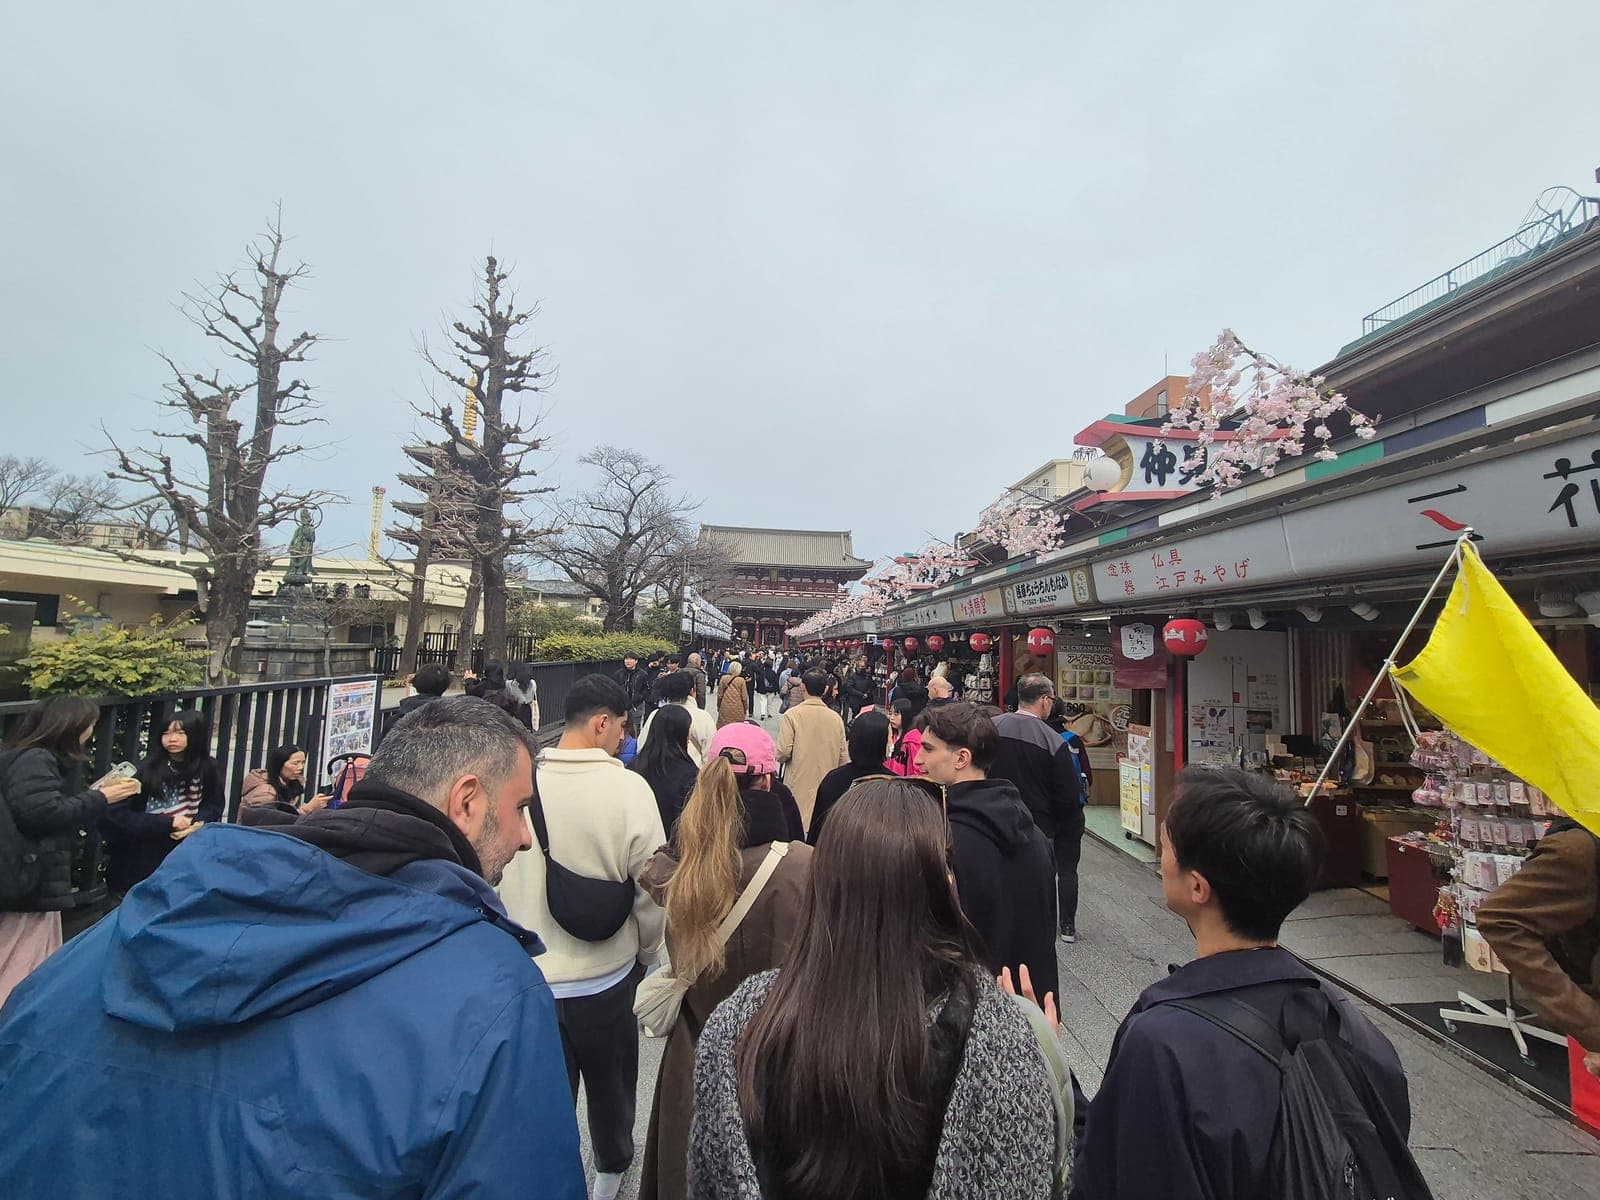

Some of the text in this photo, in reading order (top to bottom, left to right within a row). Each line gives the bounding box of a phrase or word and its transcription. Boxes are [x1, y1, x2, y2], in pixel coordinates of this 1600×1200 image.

[1140, 441, 1252, 487] 仲見
[1107, 548, 1183, 577] 念珠 仏具
[1155, 557, 1251, 591] 江戸みやげ
[1065, 653, 1115, 665] アイスもな
